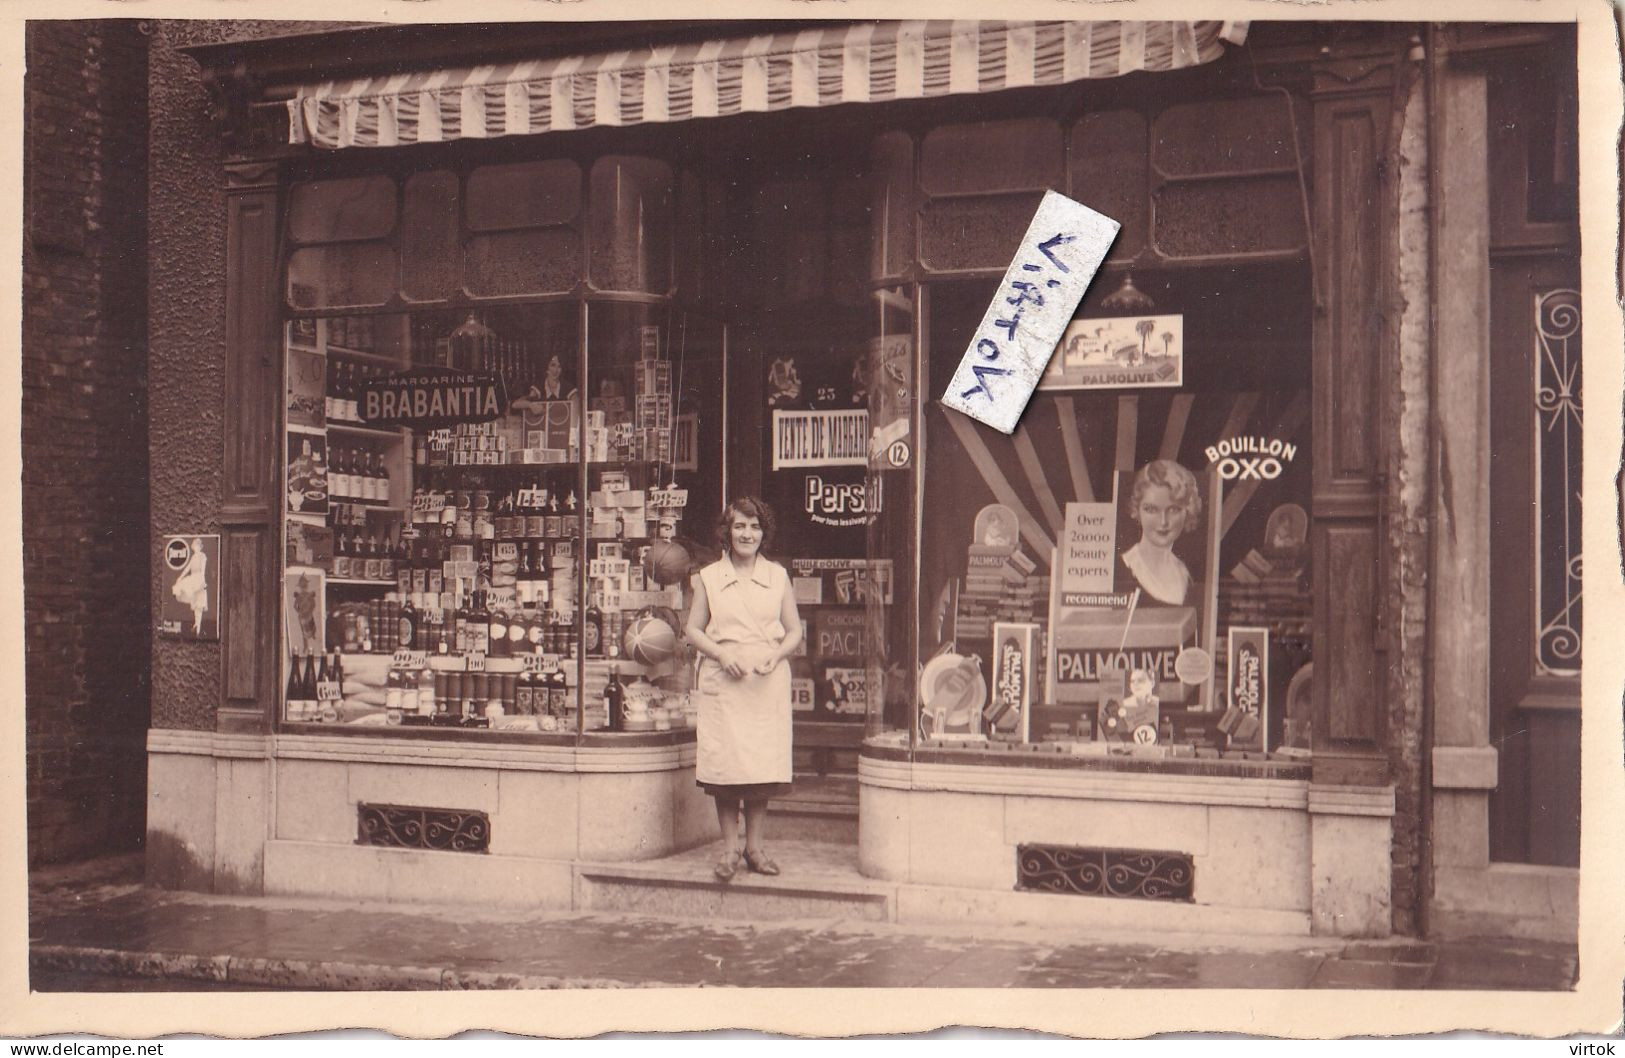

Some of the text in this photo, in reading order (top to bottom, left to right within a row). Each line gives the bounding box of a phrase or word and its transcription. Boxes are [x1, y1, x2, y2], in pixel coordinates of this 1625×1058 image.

[388, 375, 475, 386] MARGARINE
[1082, 372, 1155, 385] PALMOLIVE
[366, 386, 499, 419] BRABANTIA
[779, 416, 808, 460] VENTE
[811, 416, 825, 459] DE
[892, 445, 904, 463] 12
[1204, 436, 1297, 463] BOUILLON
[1217, 458, 1283, 480] OXO
[805, 475, 883, 513] Persil
[1077, 514, 1105, 526] Over
[1070, 547, 1108, 561] beauty
[1067, 565, 1109, 579] experts
[1065, 594, 1127, 606] recommend
[1057, 651, 1175, 680] PALMOLIVE
[1011, 651, 1022, 713] PALMOLIV
[1248, 656, 1259, 721] PALMOLIV
[1137, 729, 1152, 744] 12
